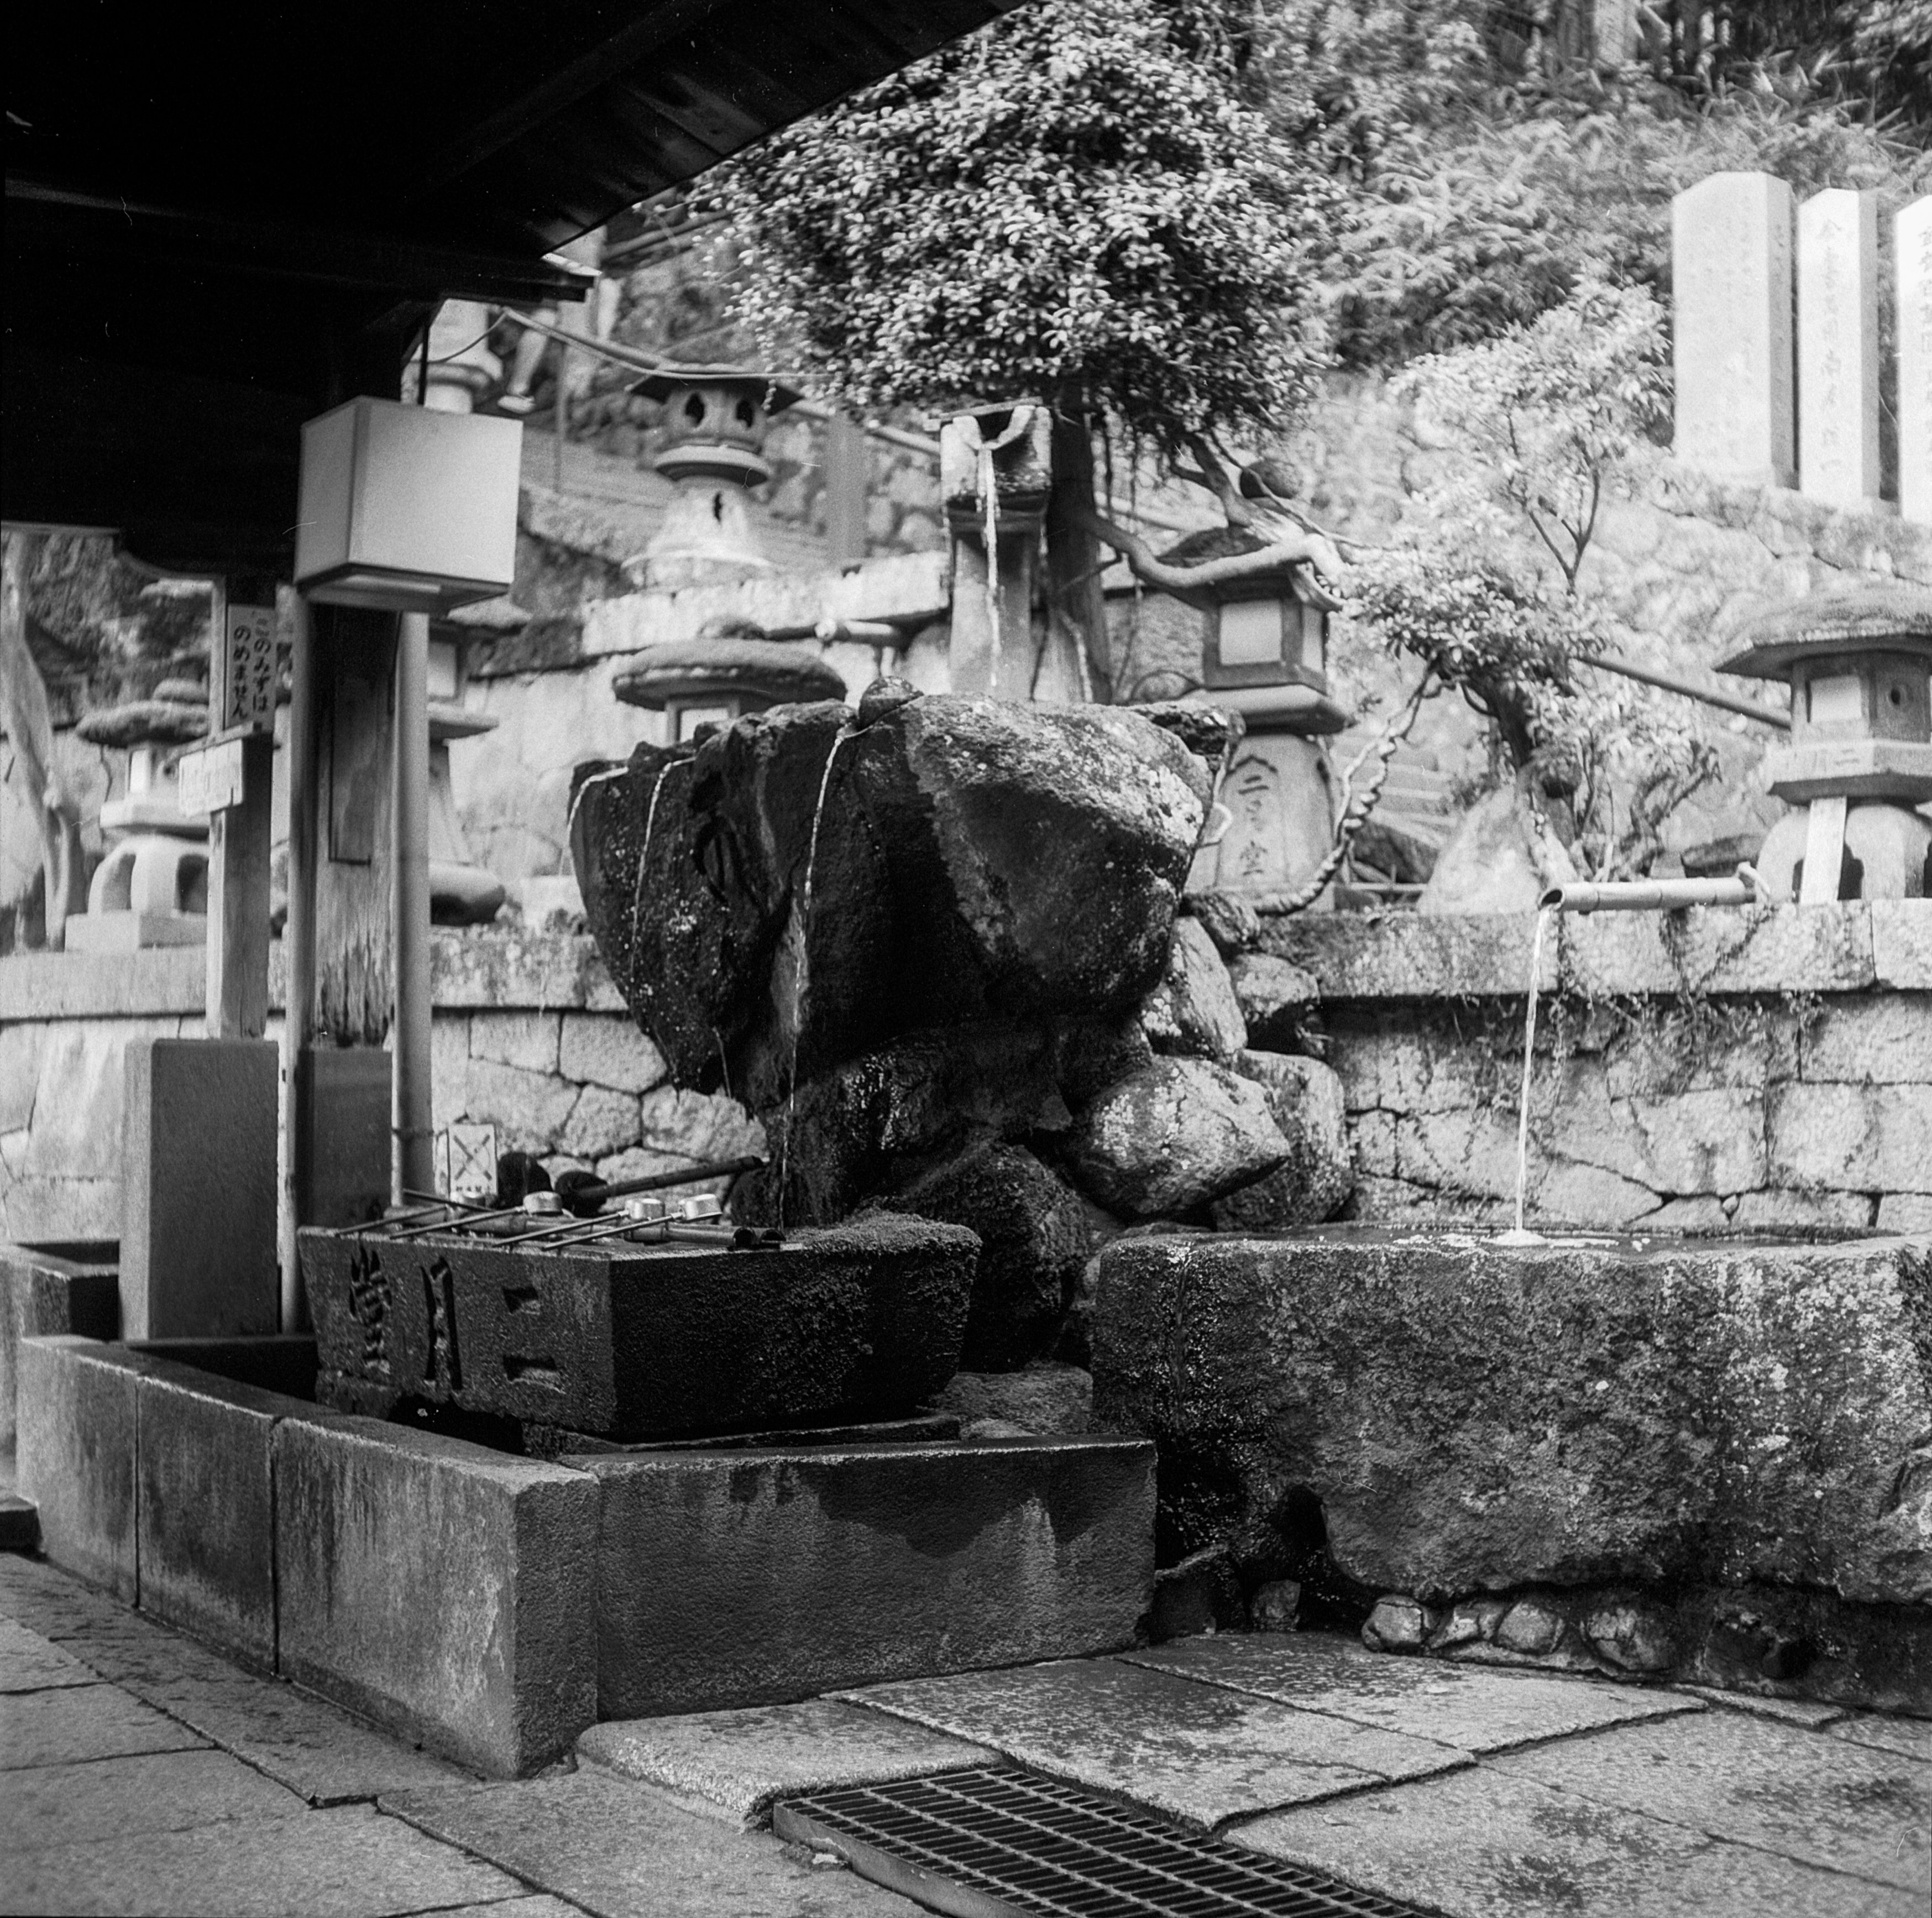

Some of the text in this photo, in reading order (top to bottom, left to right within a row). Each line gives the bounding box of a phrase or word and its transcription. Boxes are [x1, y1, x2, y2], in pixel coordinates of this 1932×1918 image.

[232, 625, 251, 719] のめません
